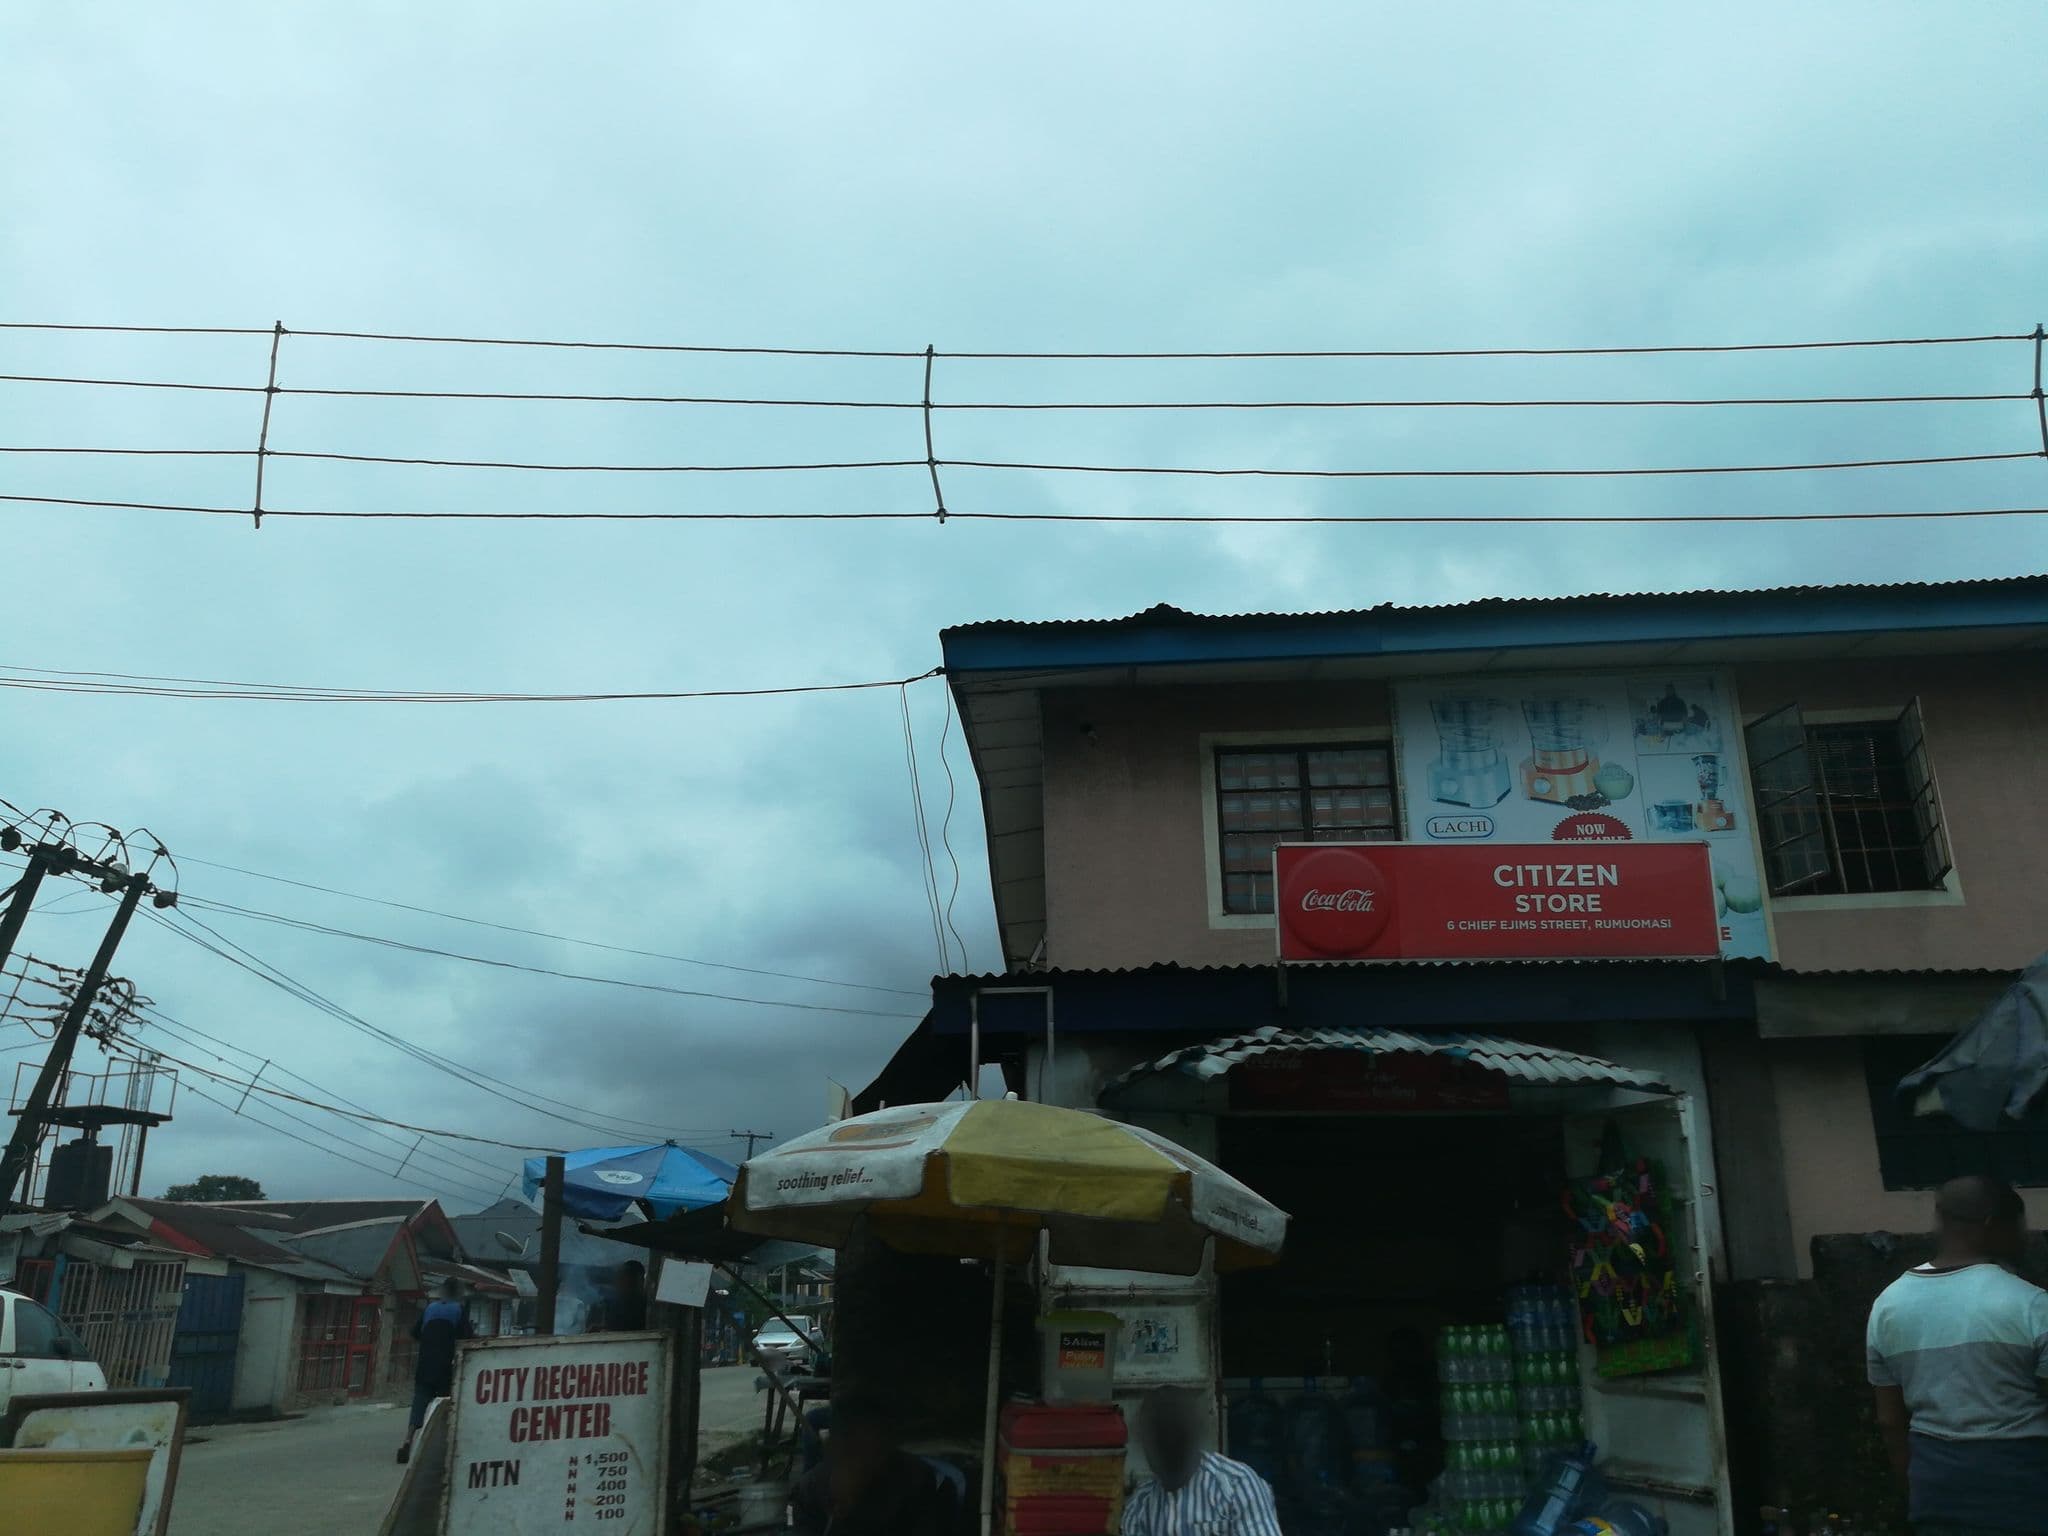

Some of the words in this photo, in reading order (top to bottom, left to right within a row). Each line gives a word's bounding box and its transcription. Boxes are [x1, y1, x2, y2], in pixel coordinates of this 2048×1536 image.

[1433, 820, 1489, 834] LACHI
[1576, 823, 1606, 836] NOW
[1493, 863, 1619, 887] CITIZEN
[1301, 888, 1375, 913] Coca-Cola
[1515, 893, 1603, 914] STORE
[1446, 919, 1456, 931] 6
[1459, 919, 1497, 931] CHIEF
[1499, 919, 1537, 931] EJIMS
[1540, 919, 1592, 932] STREET,
[1594, 918, 1672, 931] RUMUOMASI
[777, 1170, 828, 1191] soothing
[475, 1367, 530, 1405] CITY
[532, 1361, 649, 1401] RECHARGE
[508, 1402, 611, 1443] CENTER
[585, 1451, 629, 1467] 1,500
[467, 1459, 521, 1490] MTN
[597, 1466, 628, 1477] 750
[596, 1480, 626, 1491] 400
[595, 1494, 625, 1506] 200
[595, 1508, 625, 1520] 100
